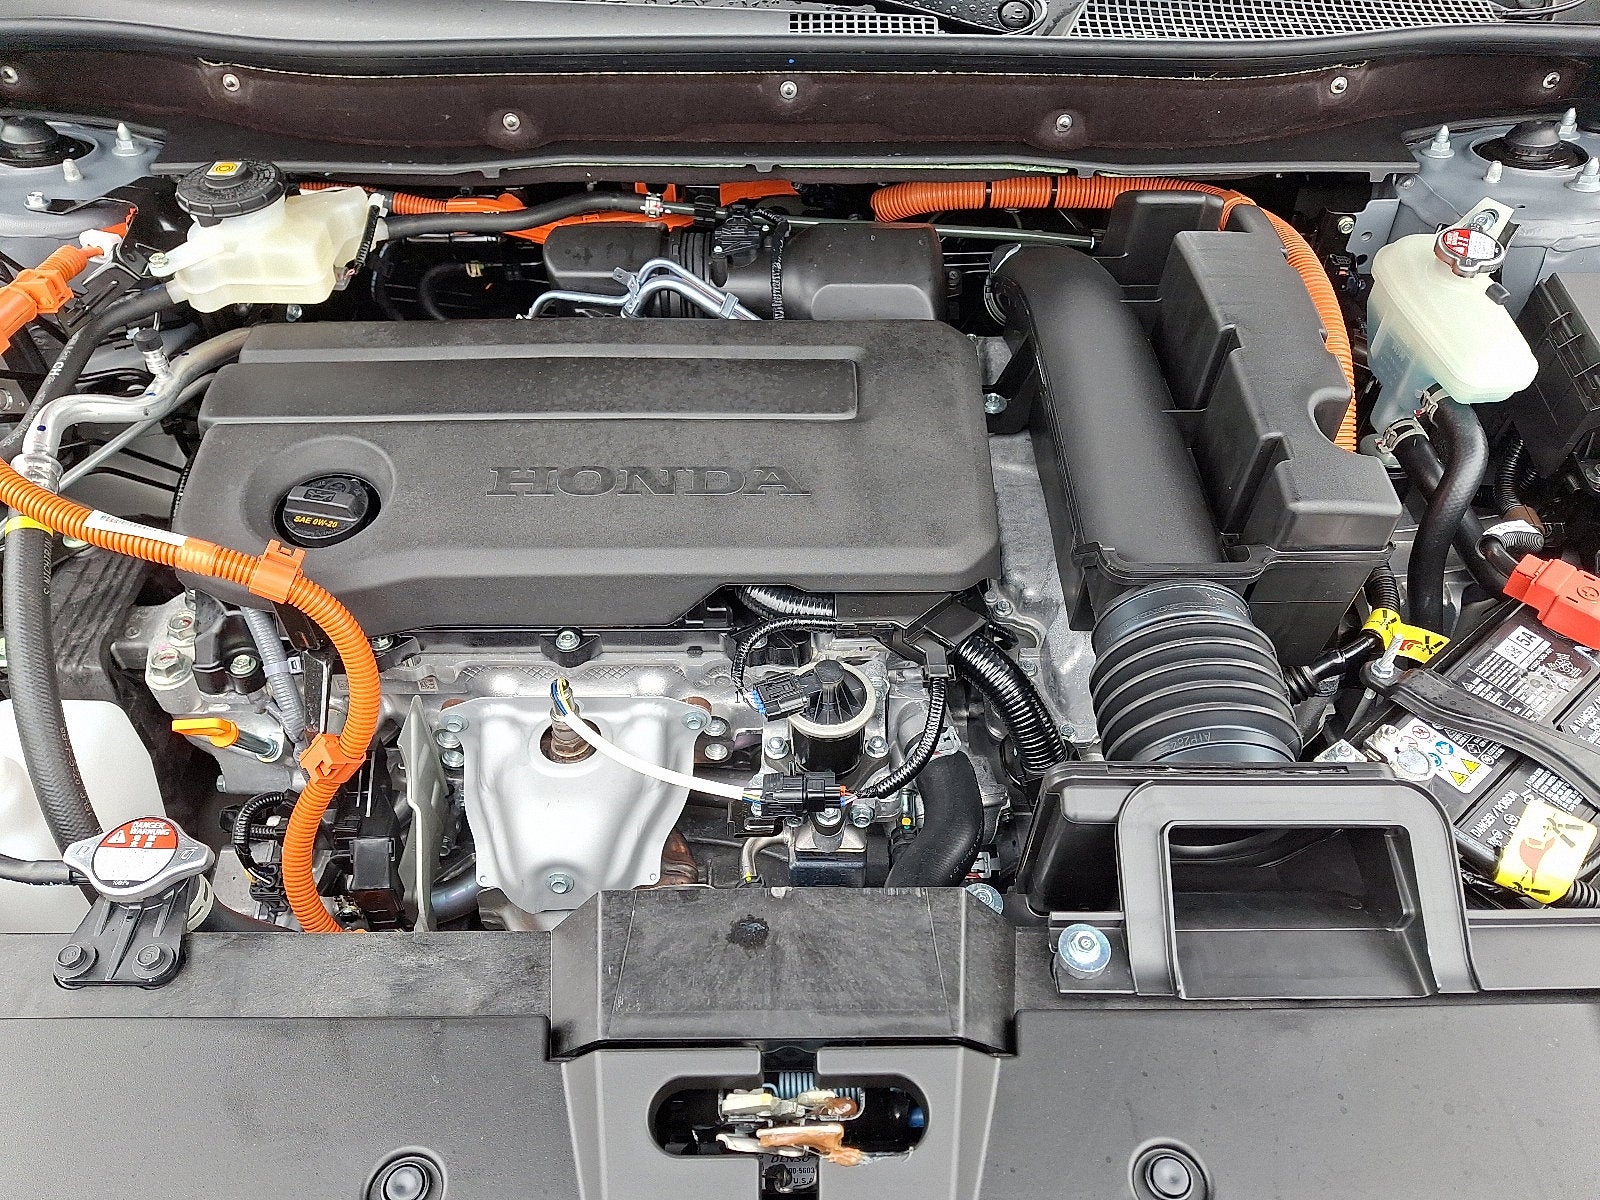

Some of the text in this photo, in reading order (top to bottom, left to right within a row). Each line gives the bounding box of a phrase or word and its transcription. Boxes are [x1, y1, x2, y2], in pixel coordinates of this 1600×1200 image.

[486, 466, 811, 496] HONDA
[293, 515, 338, 528] SAE 0W-20
[1516, 631, 1537, 646] 5A
[132, 821, 167, 829] DANGER
[129, 828, 171, 836] WARNING
